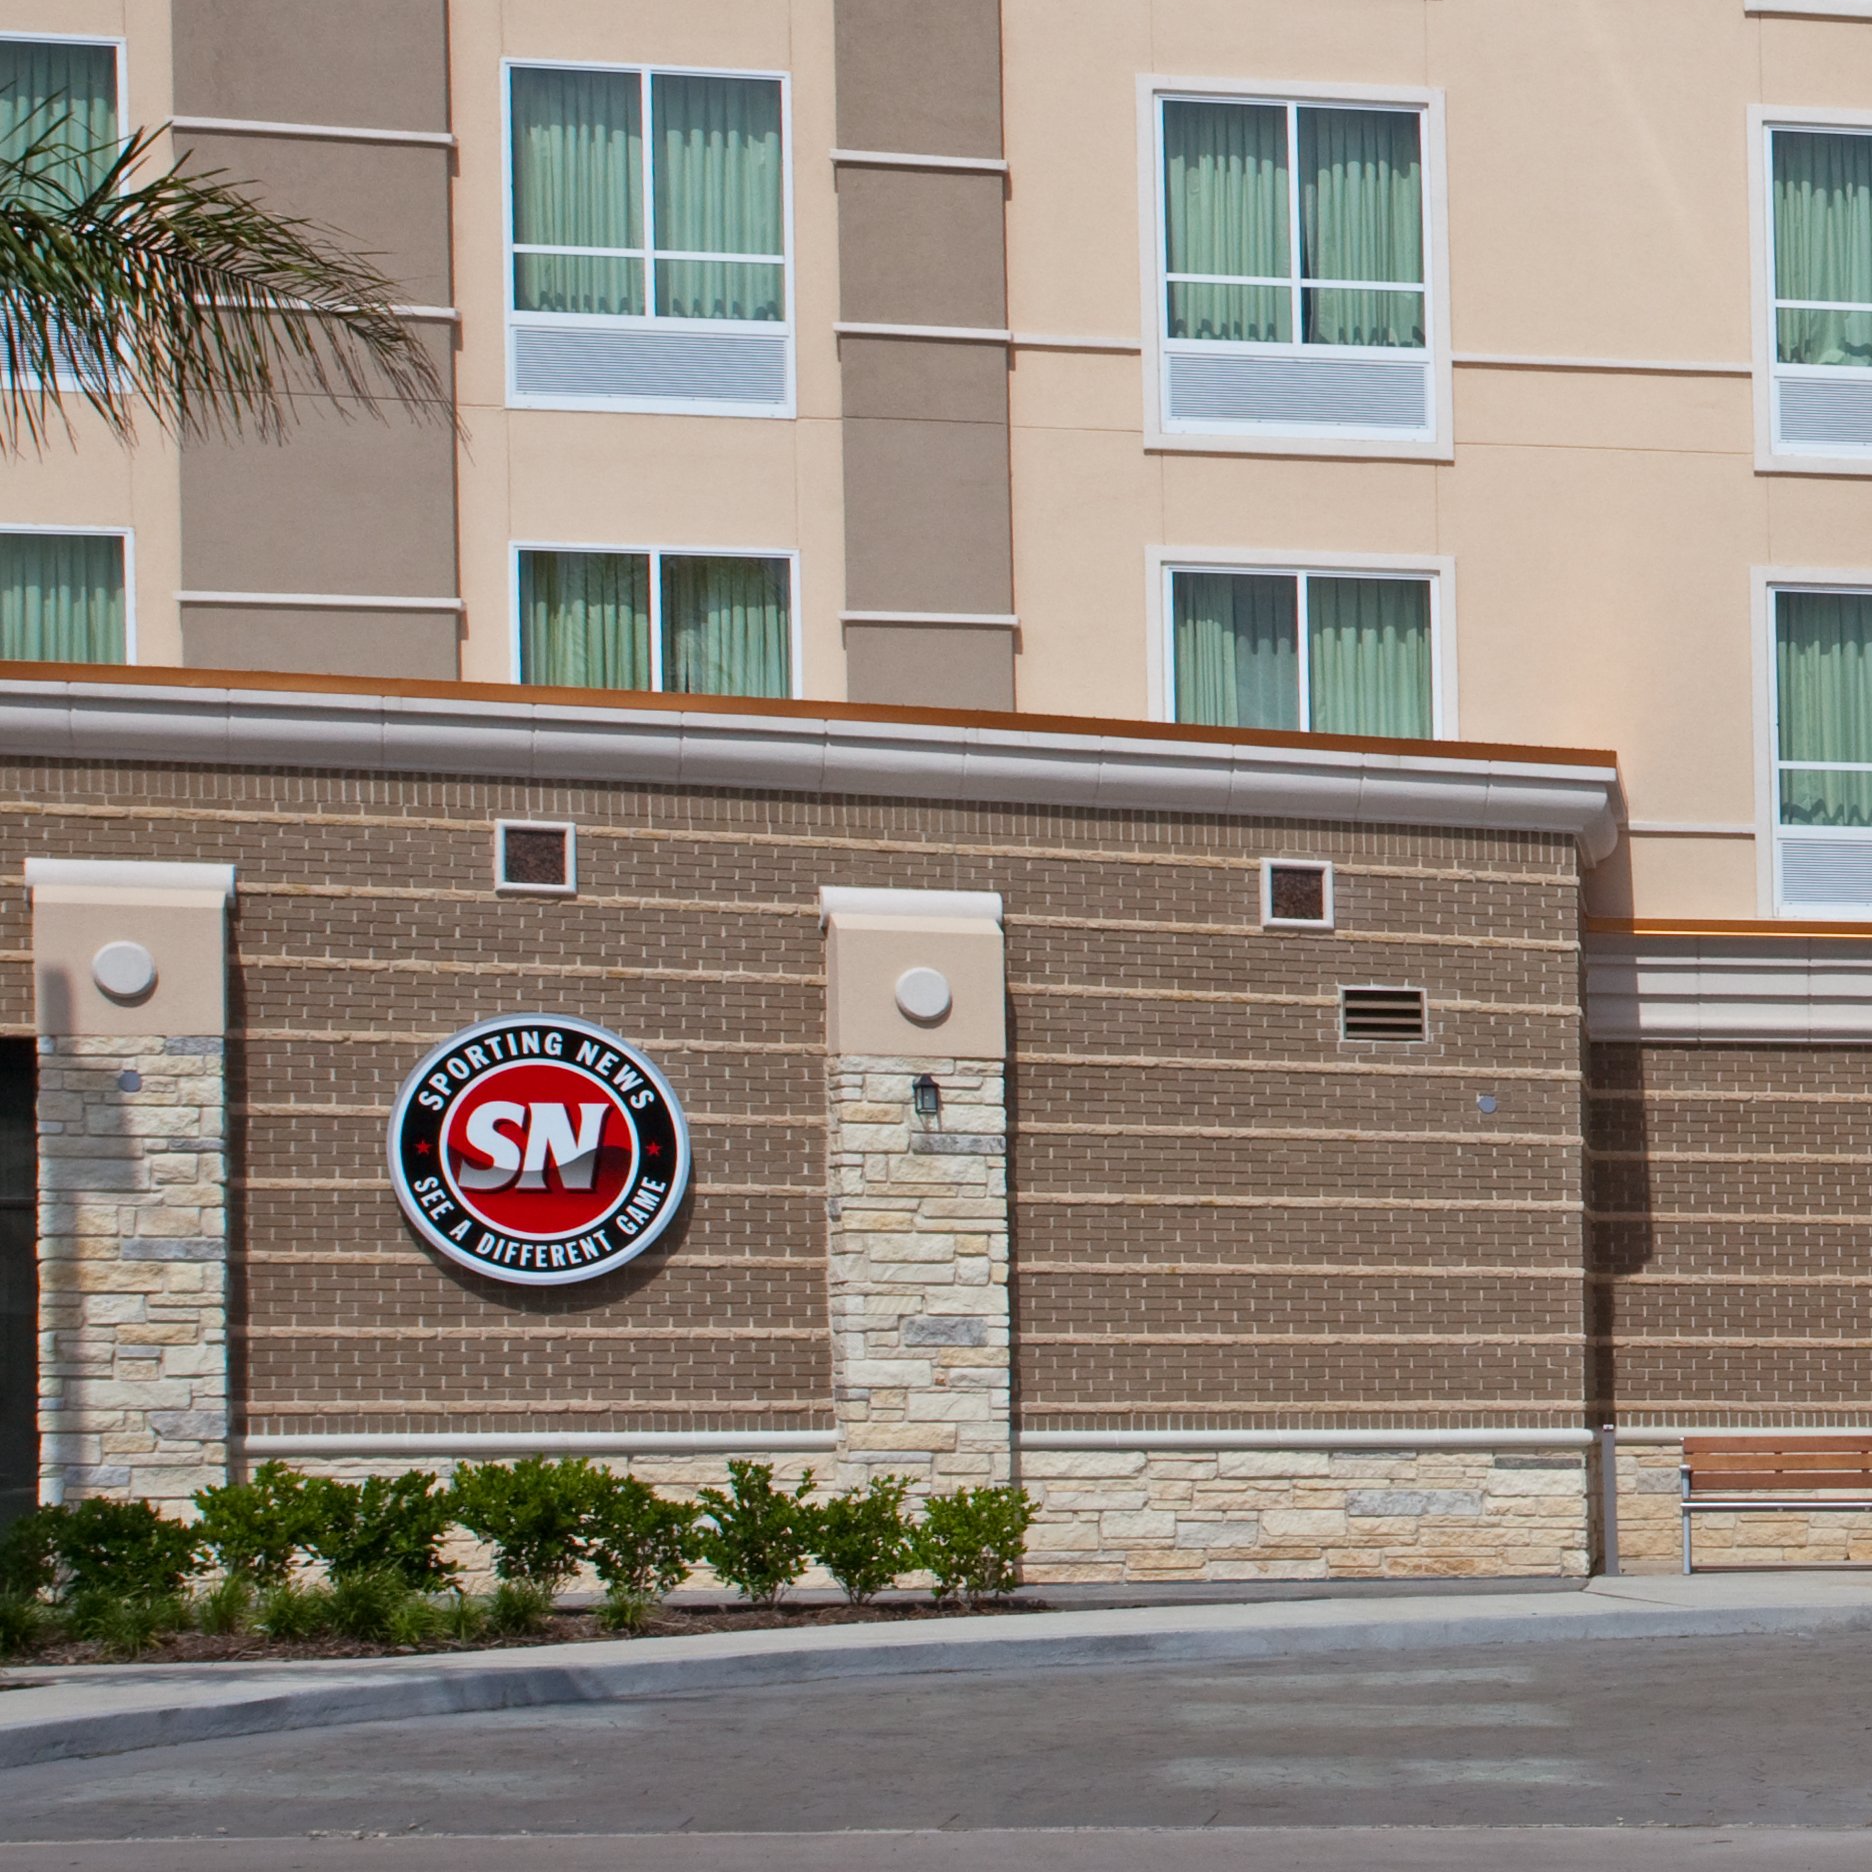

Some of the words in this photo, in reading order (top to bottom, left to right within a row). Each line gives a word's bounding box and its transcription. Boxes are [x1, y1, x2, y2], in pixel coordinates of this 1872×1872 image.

[418, 1030, 563, 1111] SPORTING
[575, 1040, 655, 1110] NEWS
[458, 1100, 610, 1191] SN
[414, 1176, 454, 1221] SEE
[449, 1219, 472, 1242] A
[475, 1229, 613, 1268] DIFFERENT
[616, 1176, 667, 1236] GAME
